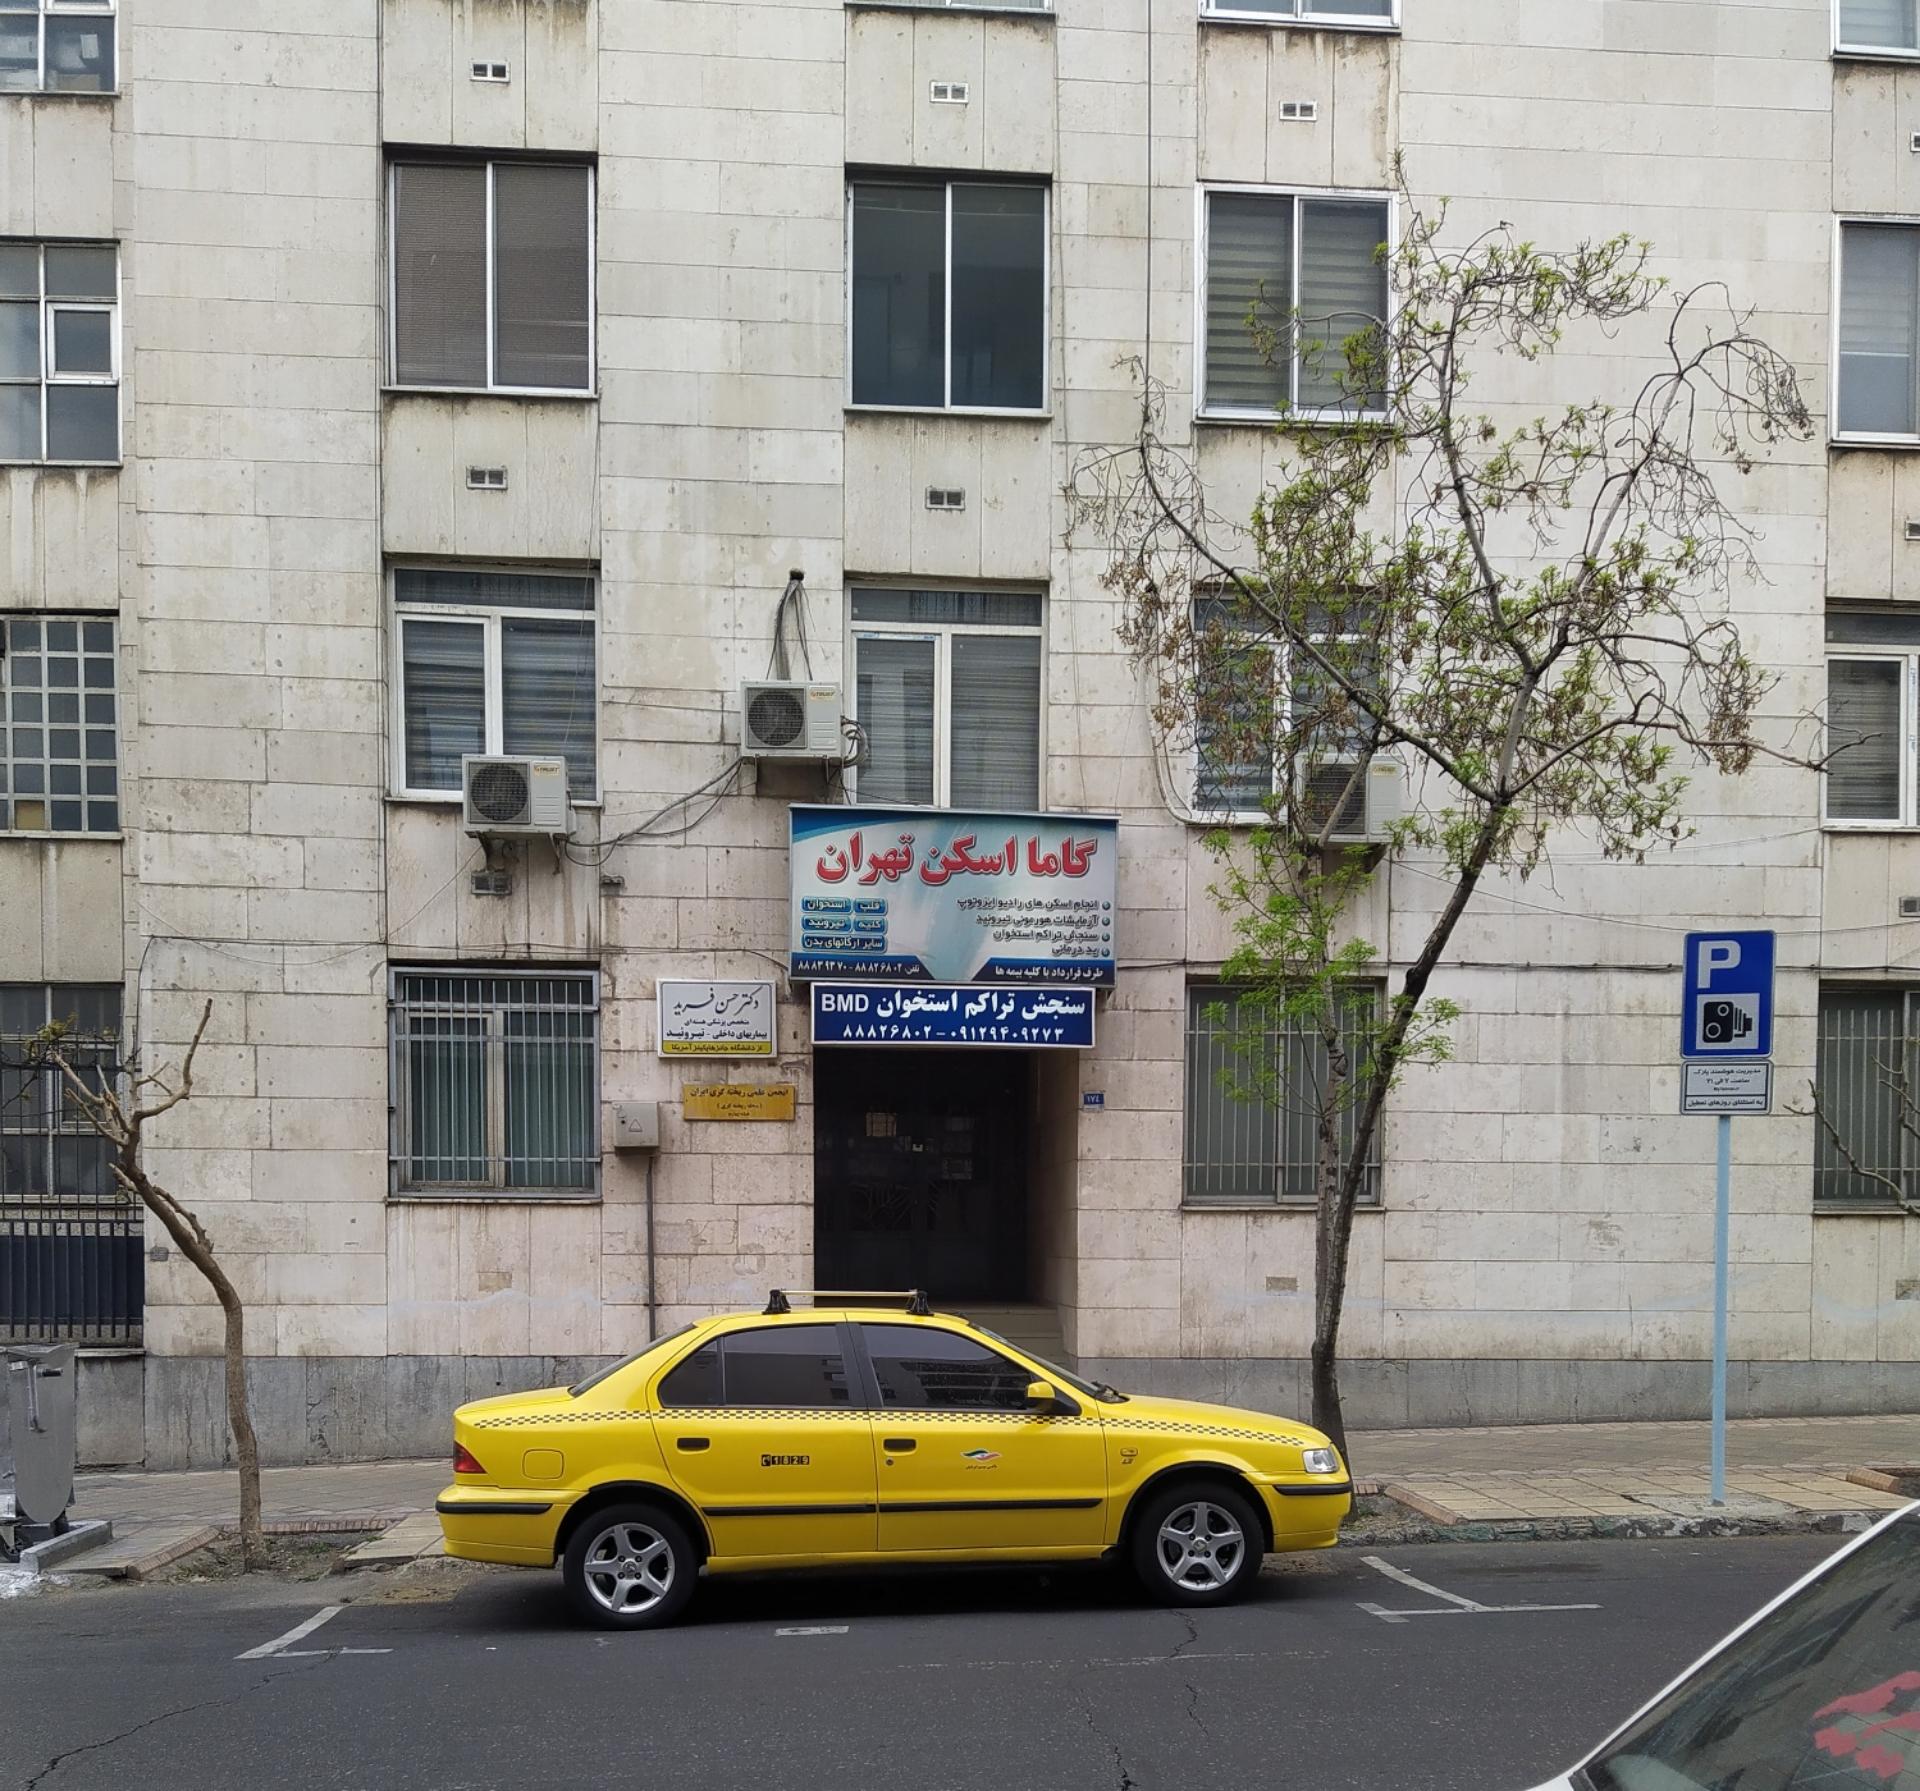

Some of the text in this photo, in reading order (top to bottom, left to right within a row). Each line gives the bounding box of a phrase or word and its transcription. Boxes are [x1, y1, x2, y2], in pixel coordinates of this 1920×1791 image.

[815, 831, 1098, 886] گاما اسکن تهران
[807, 899, 846, 911] استخوان
[859, 901, 880, 911] قلب
[999, 899, 1022, 909] رادیو
[1025, 899, 1043, 910] های
[1045, 898, 1071, 910] اسکن
[1073, 899, 1098, 911] انجام
[858, 918, 881, 929] کلیه
[1013, 915, 1051, 927] هورمونی
[1053, 914, 1099, 928] آزمایشات
[992, 929, 1099, 942] سنجش تراکم استخوان
[804, 937, 824, 949] بدن
[862, 939, 883, 949] سایر
[1697, 939, 1742, 989] P
[1006, 968, 1023, 979] بیمه
[1024, 966, 1042, 978] کلیه
[1042, 967, 1050, 978] با
[1051, 967, 1082, 980] قرارداد
[1082, 970, 1104, 981] طرف
[673, 985, 764, 1016] دکتر حسن فرید
[821, 990, 1086, 1020] سنجش تراکم استخوان BMD
[712, 1028, 735, 1040] داخلی
[842, 1023, 932, 1040] ۸۸۸۲۶۸۰۲
[950, 1024, 1064, 1042] ۰۹۱۲۹۴۰۹۲۷۳
